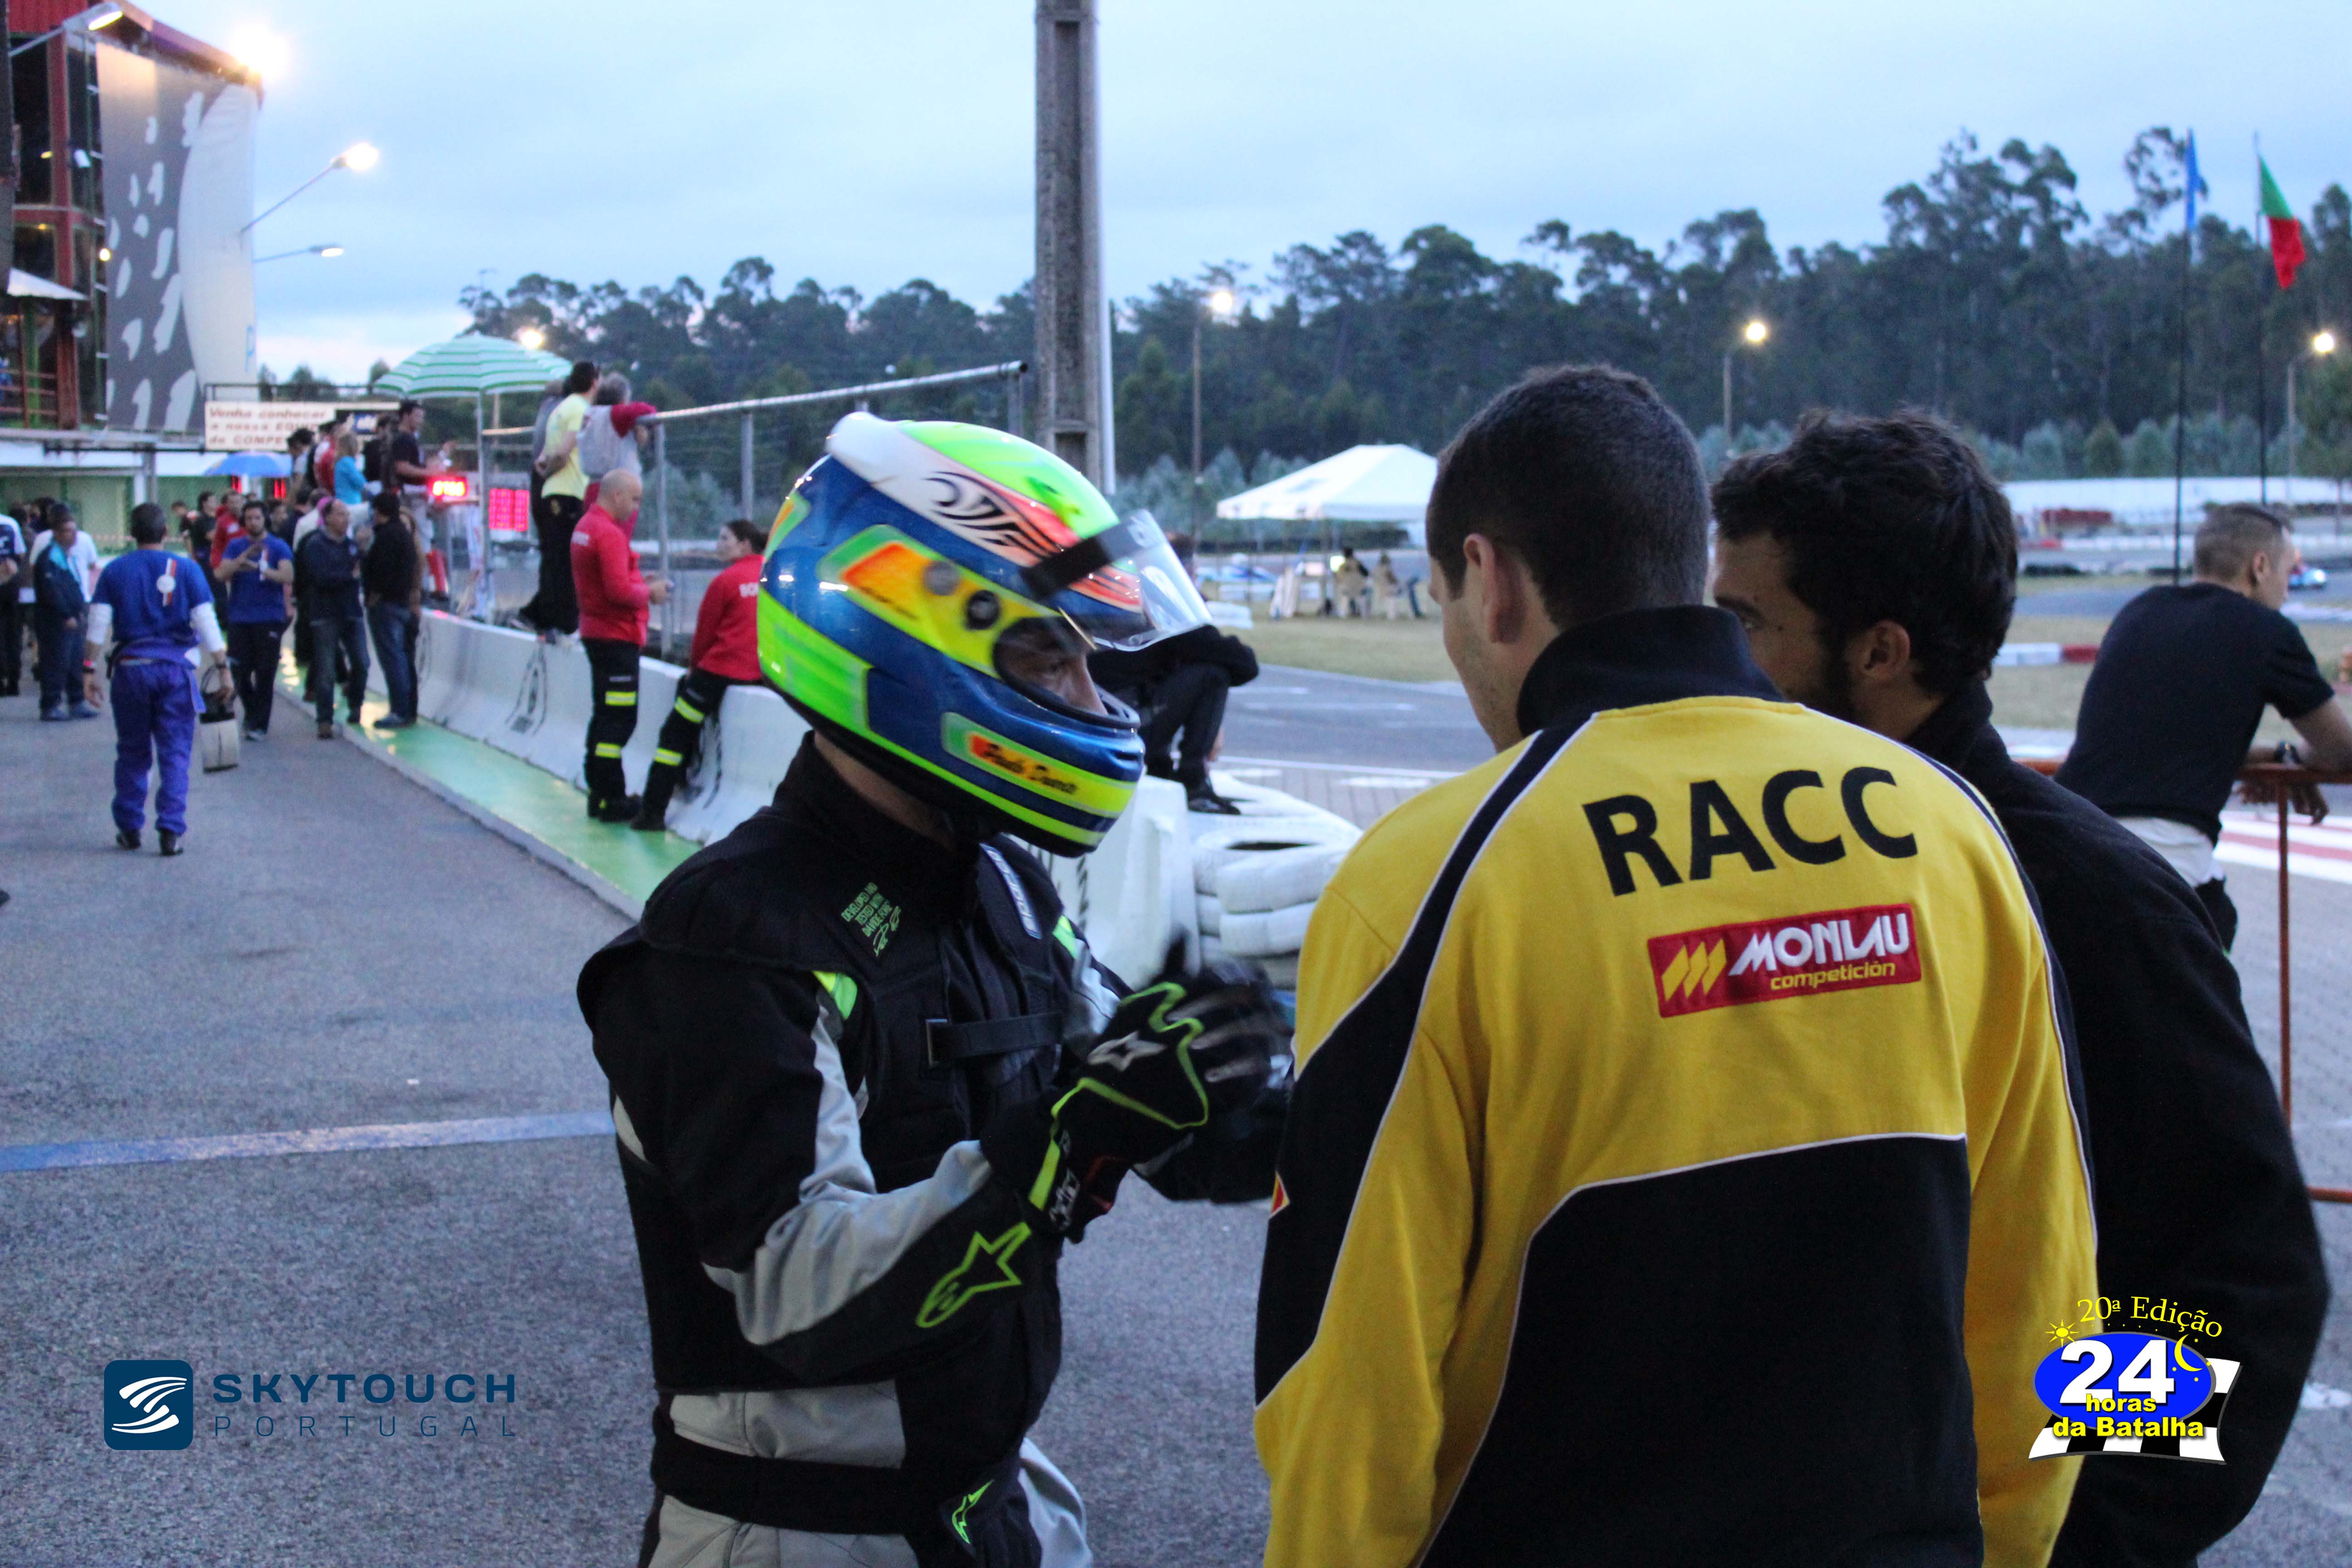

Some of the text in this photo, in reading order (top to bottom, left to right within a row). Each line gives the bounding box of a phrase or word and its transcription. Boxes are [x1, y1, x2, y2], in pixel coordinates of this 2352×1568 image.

[210, 409, 251, 417] Venha
[1582, 766, 1918, 896] RACC
[1729, 913, 1910, 976] MONLAU
[1770, 960, 1895, 991] competición
